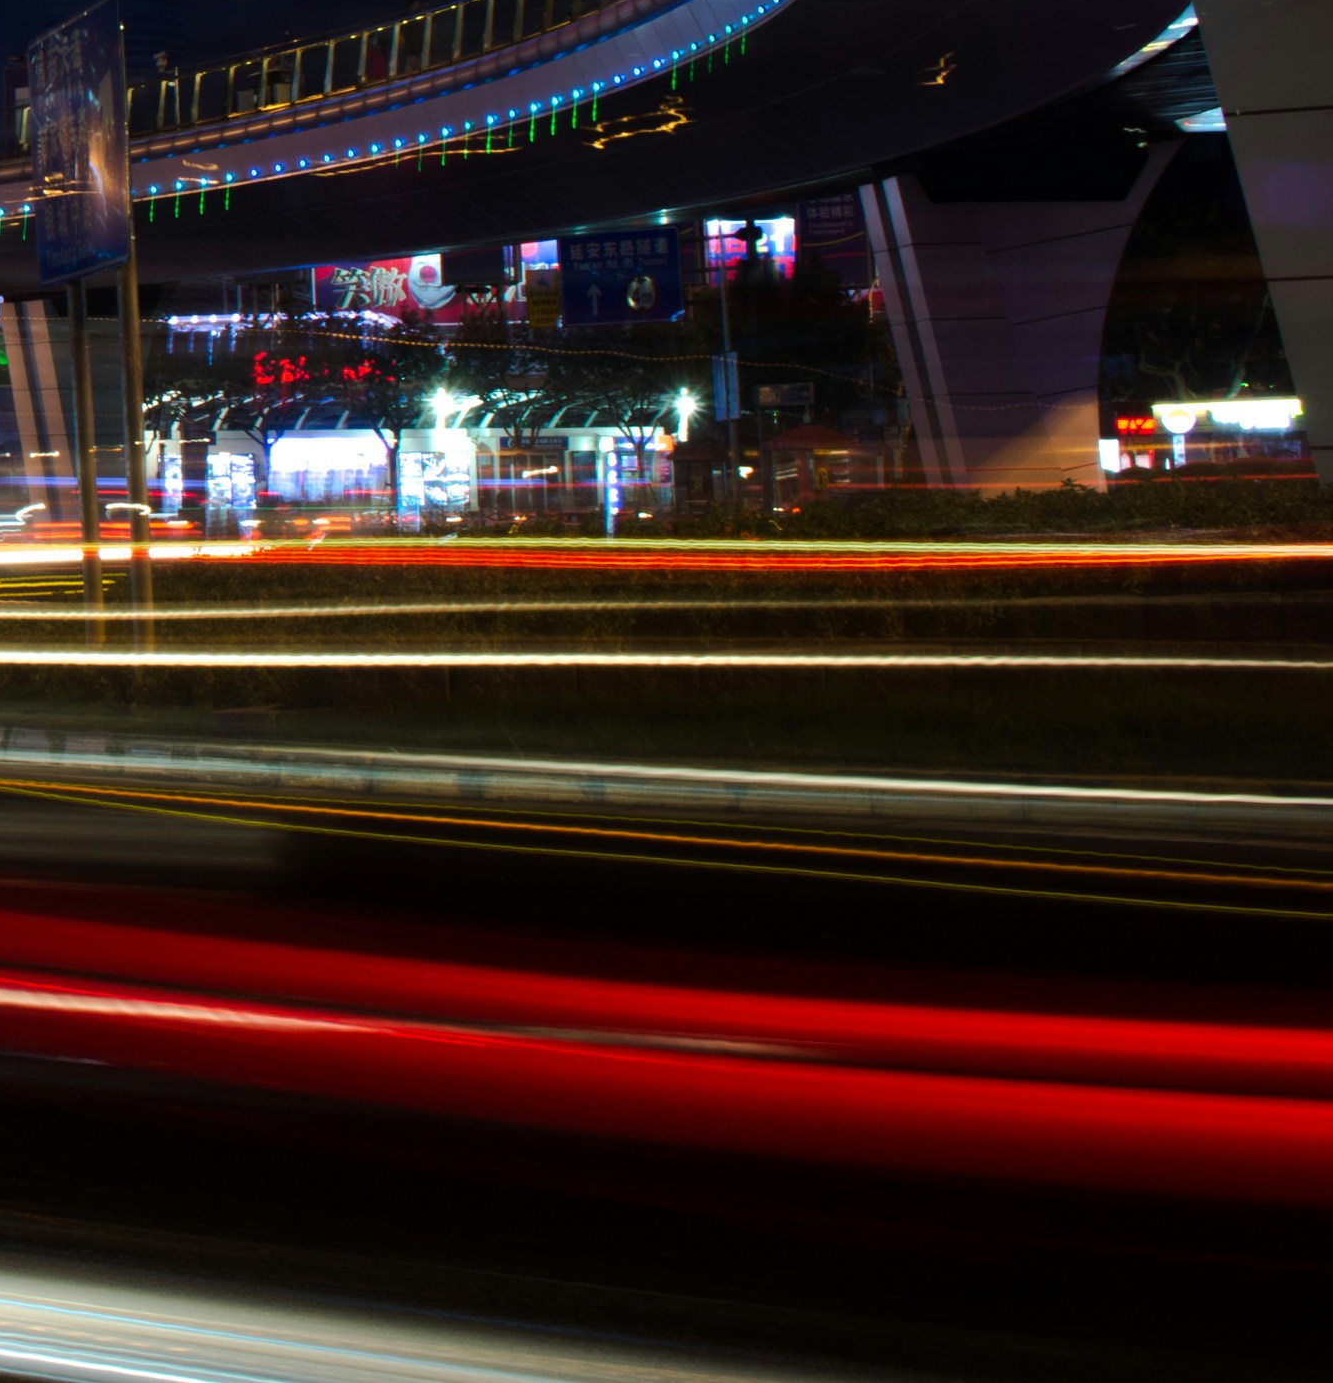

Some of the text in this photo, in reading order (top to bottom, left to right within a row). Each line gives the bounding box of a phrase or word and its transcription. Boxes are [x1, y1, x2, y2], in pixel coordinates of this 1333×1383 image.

[569, 236, 669, 260] 延安东路隧道
